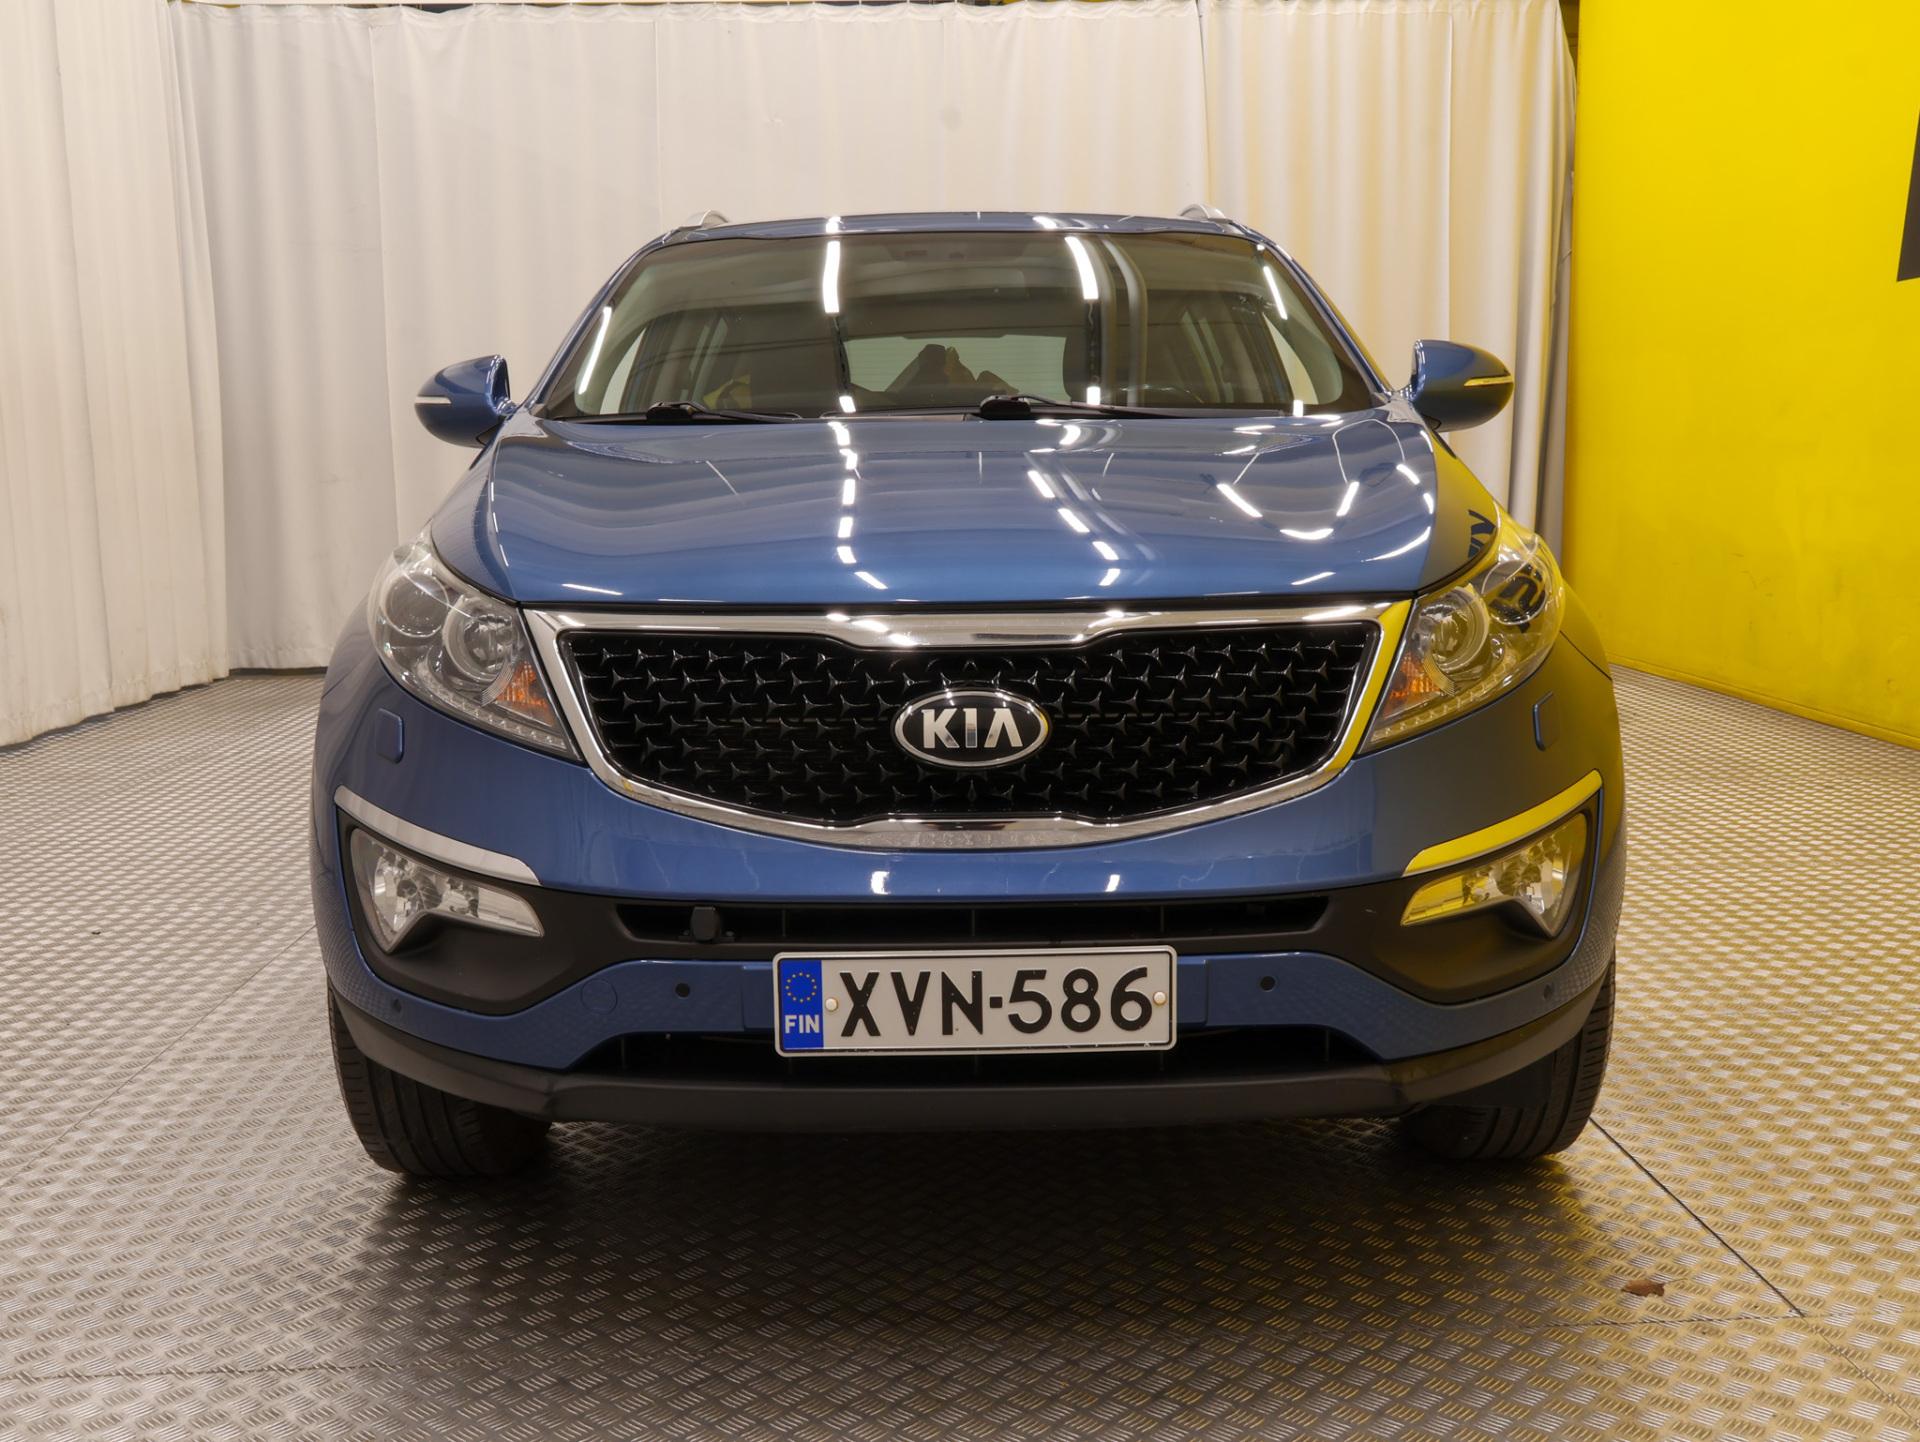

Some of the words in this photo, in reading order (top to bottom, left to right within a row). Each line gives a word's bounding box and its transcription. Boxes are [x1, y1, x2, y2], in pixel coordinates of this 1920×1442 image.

[921, 708, 1023, 749] KIA
[839, 967, 1153, 1037] XVN-586
[784, 1014, 820, 1034] FIN
